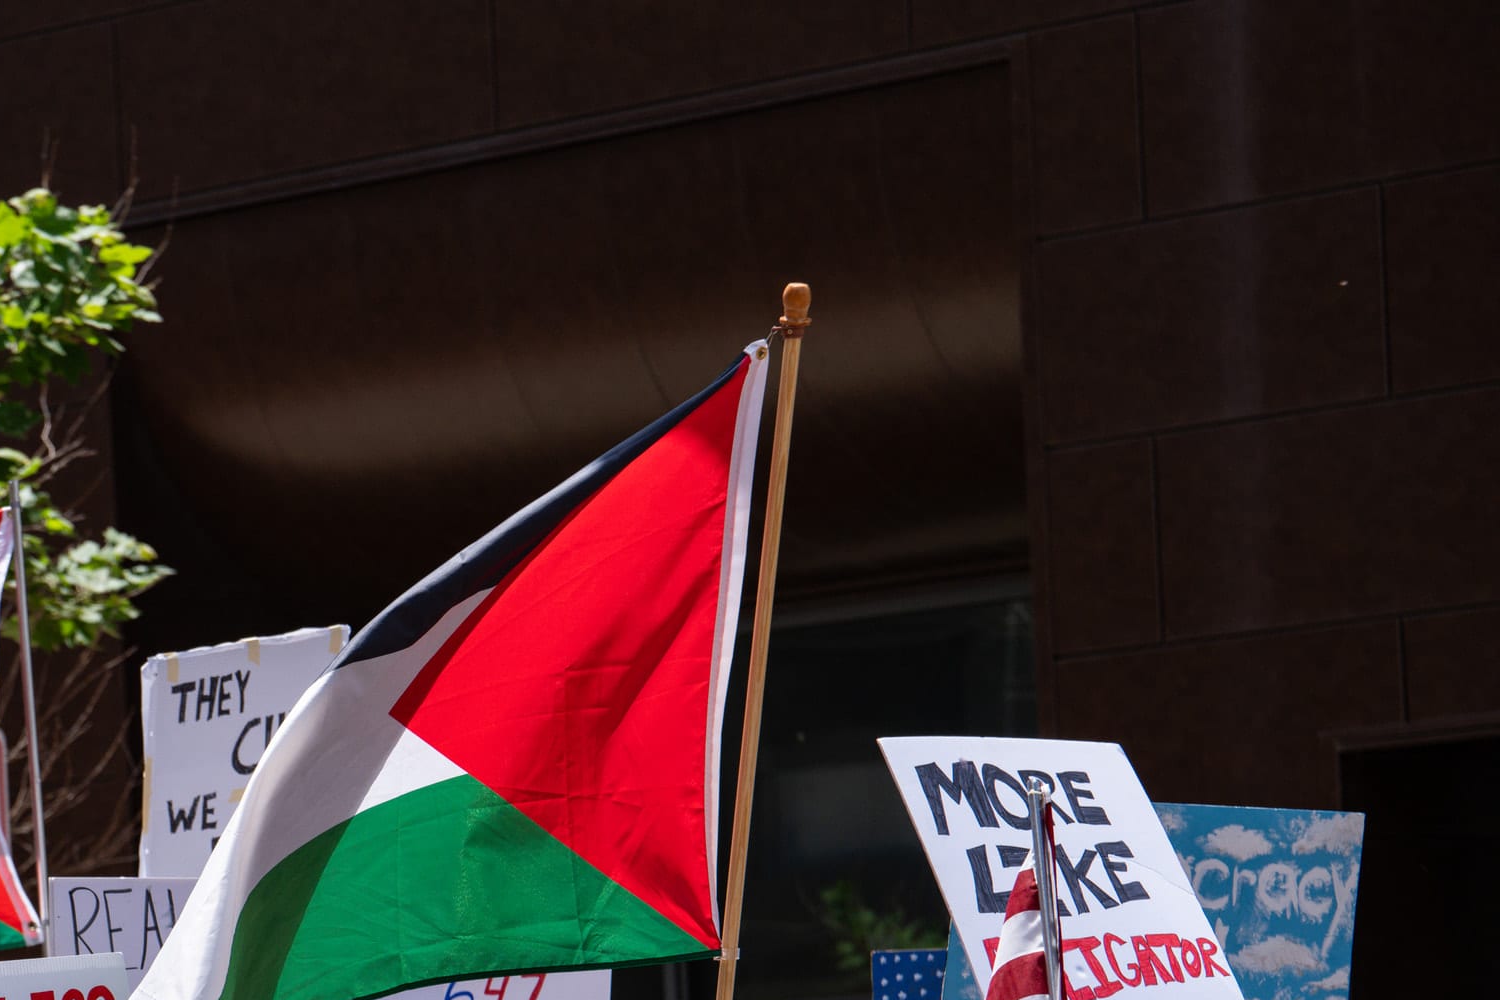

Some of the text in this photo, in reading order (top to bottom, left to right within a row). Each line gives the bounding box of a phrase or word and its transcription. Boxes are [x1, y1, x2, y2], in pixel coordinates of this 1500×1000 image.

[171, 669, 251, 724] THEY
[167, 792, 218, 834] WE
[914, 760, 1112, 837] MORE
